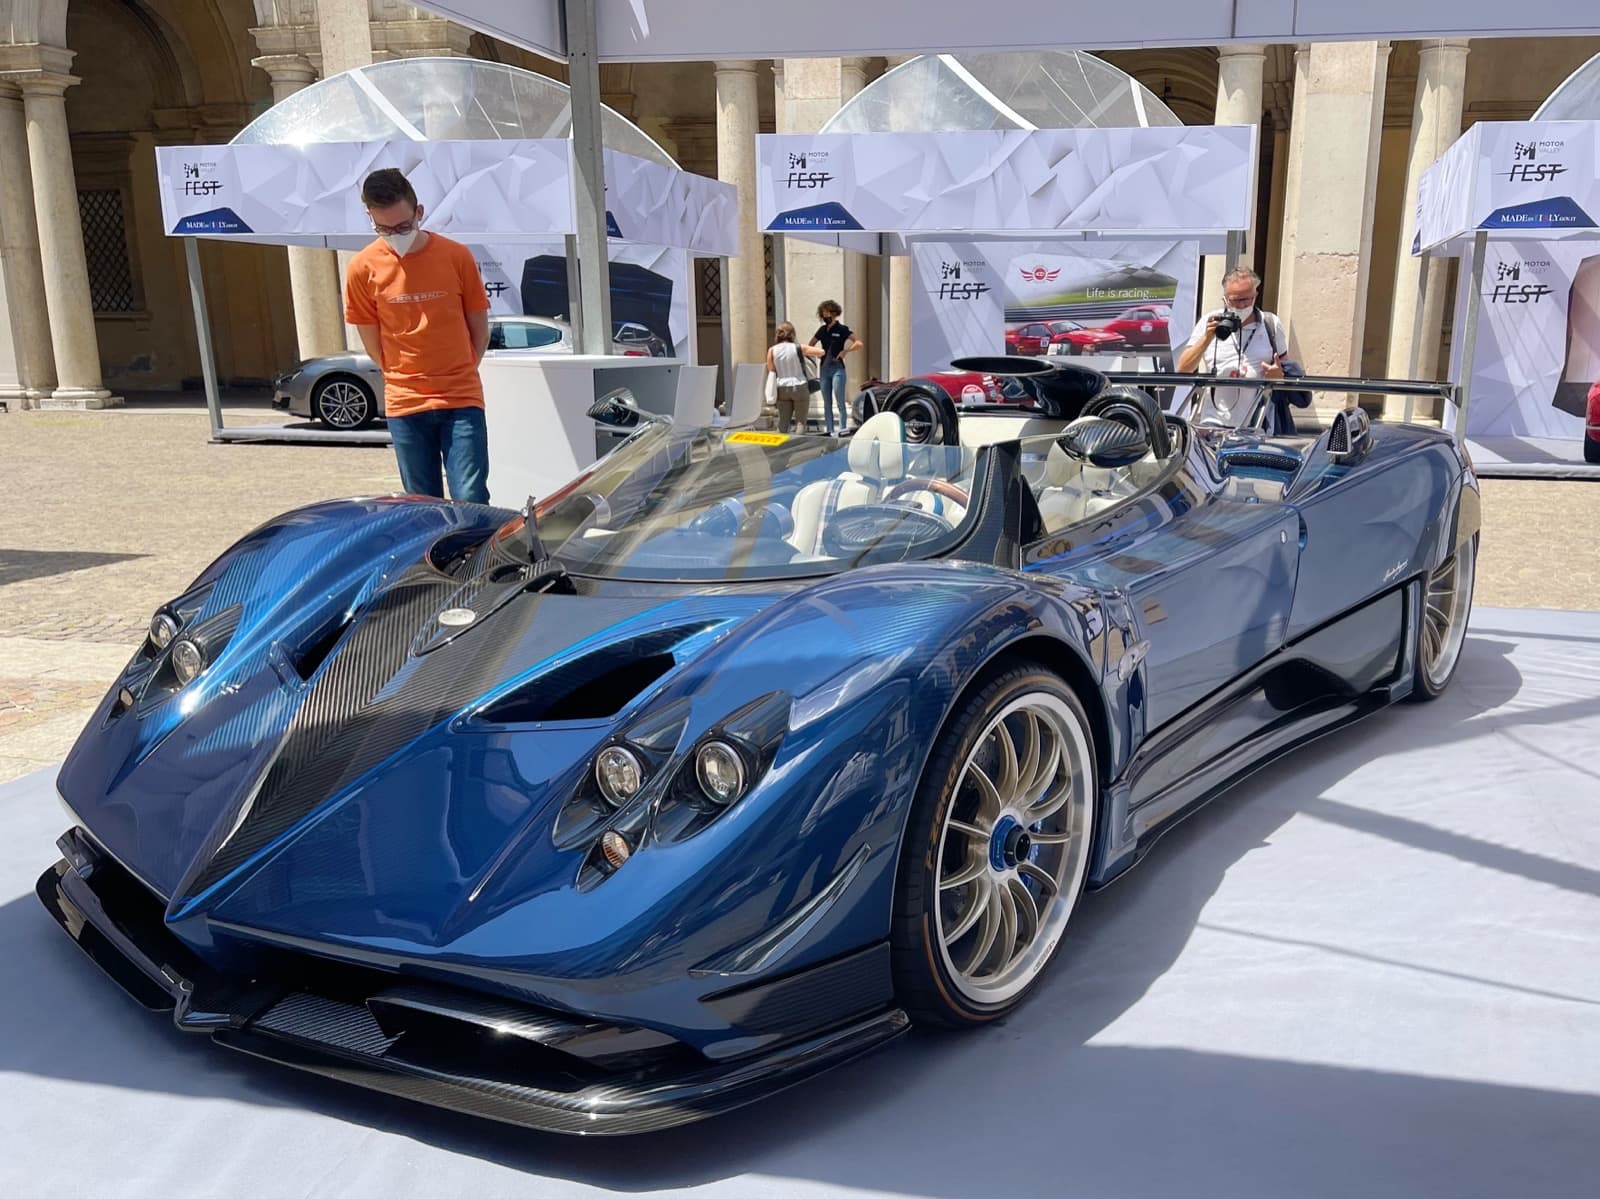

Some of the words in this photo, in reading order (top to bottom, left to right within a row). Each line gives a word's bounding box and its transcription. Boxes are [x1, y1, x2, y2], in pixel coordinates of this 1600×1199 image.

[787, 172, 830, 189] FEST
[1508, 163, 1563, 182] FEST
[185, 180, 220, 196] FEST
[484, 282, 505, 298] ST
[939, 282, 986, 300] FEST
[1086, 287, 1105, 299] Life
[1108, 287, 1116, 299] is
[1491, 284, 1549, 304] FEST
